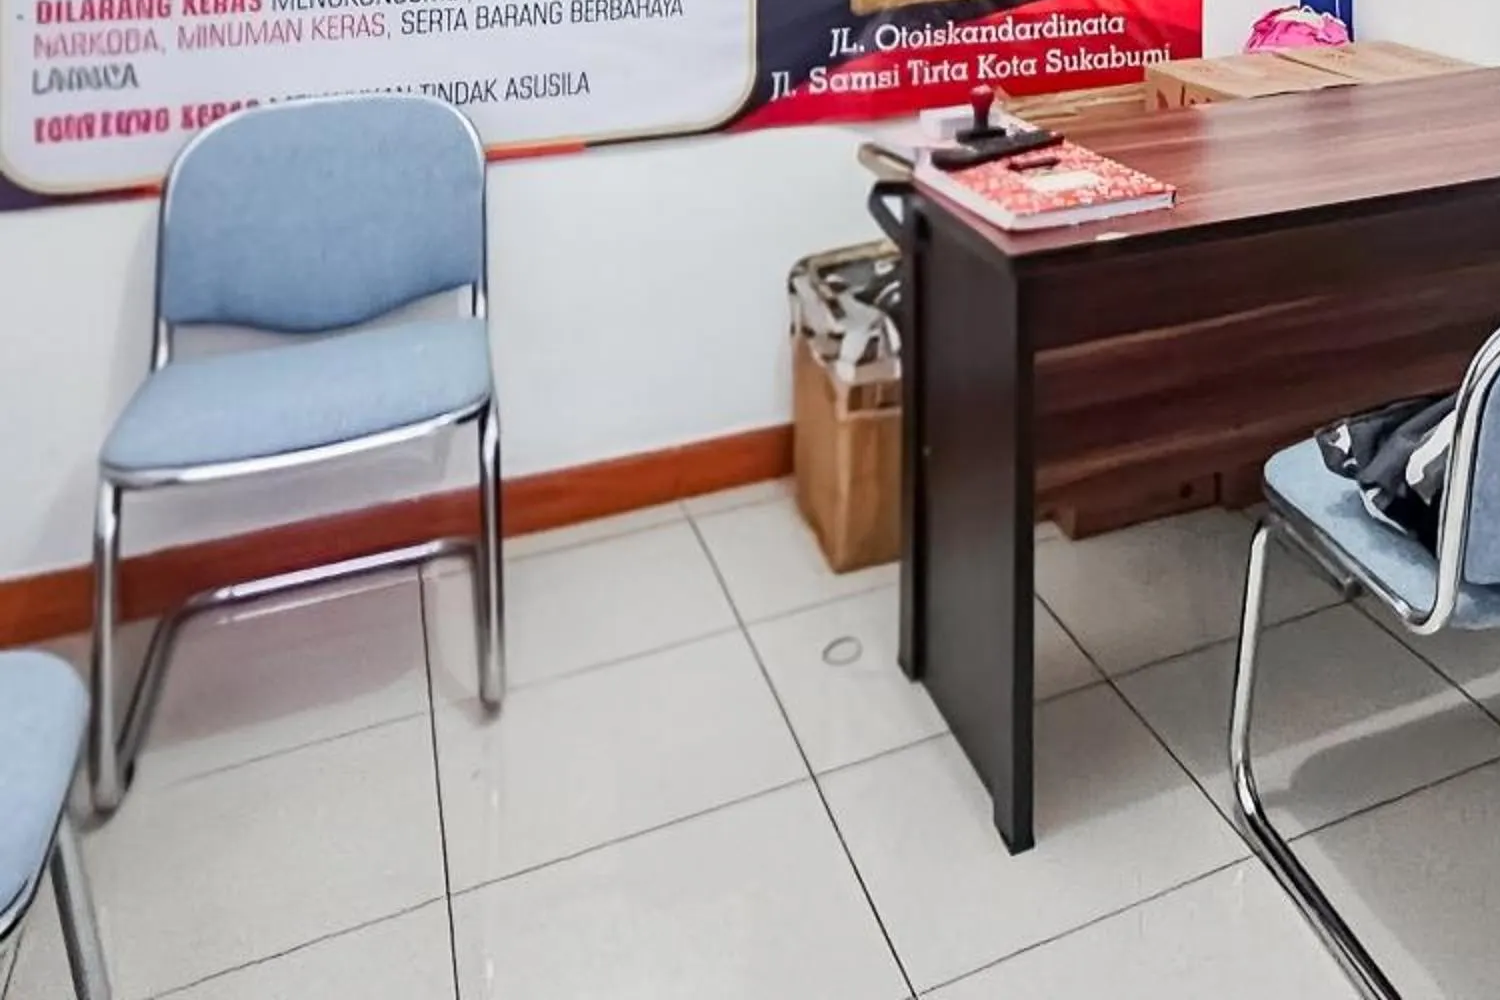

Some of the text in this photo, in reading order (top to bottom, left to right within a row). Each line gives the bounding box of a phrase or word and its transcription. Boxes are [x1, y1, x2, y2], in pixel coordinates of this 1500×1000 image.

[177, 18, 303, 51] MINUMAN
[311, 12, 391, 42] KERAS,
[400, 5, 468, 35] SERTA
[475, 1, 563, 30] BARANG
[829, 14, 1126, 58] JL. Otoiskandardinata
[504, 71, 591, 100] ASUSILA
[808, 62, 901, 95] Samsi
[907, 60, 969, 83] Tirta
[977, 52, 1037, 80] Kota
[1044, 43, 1172, 75] Sukabumi
